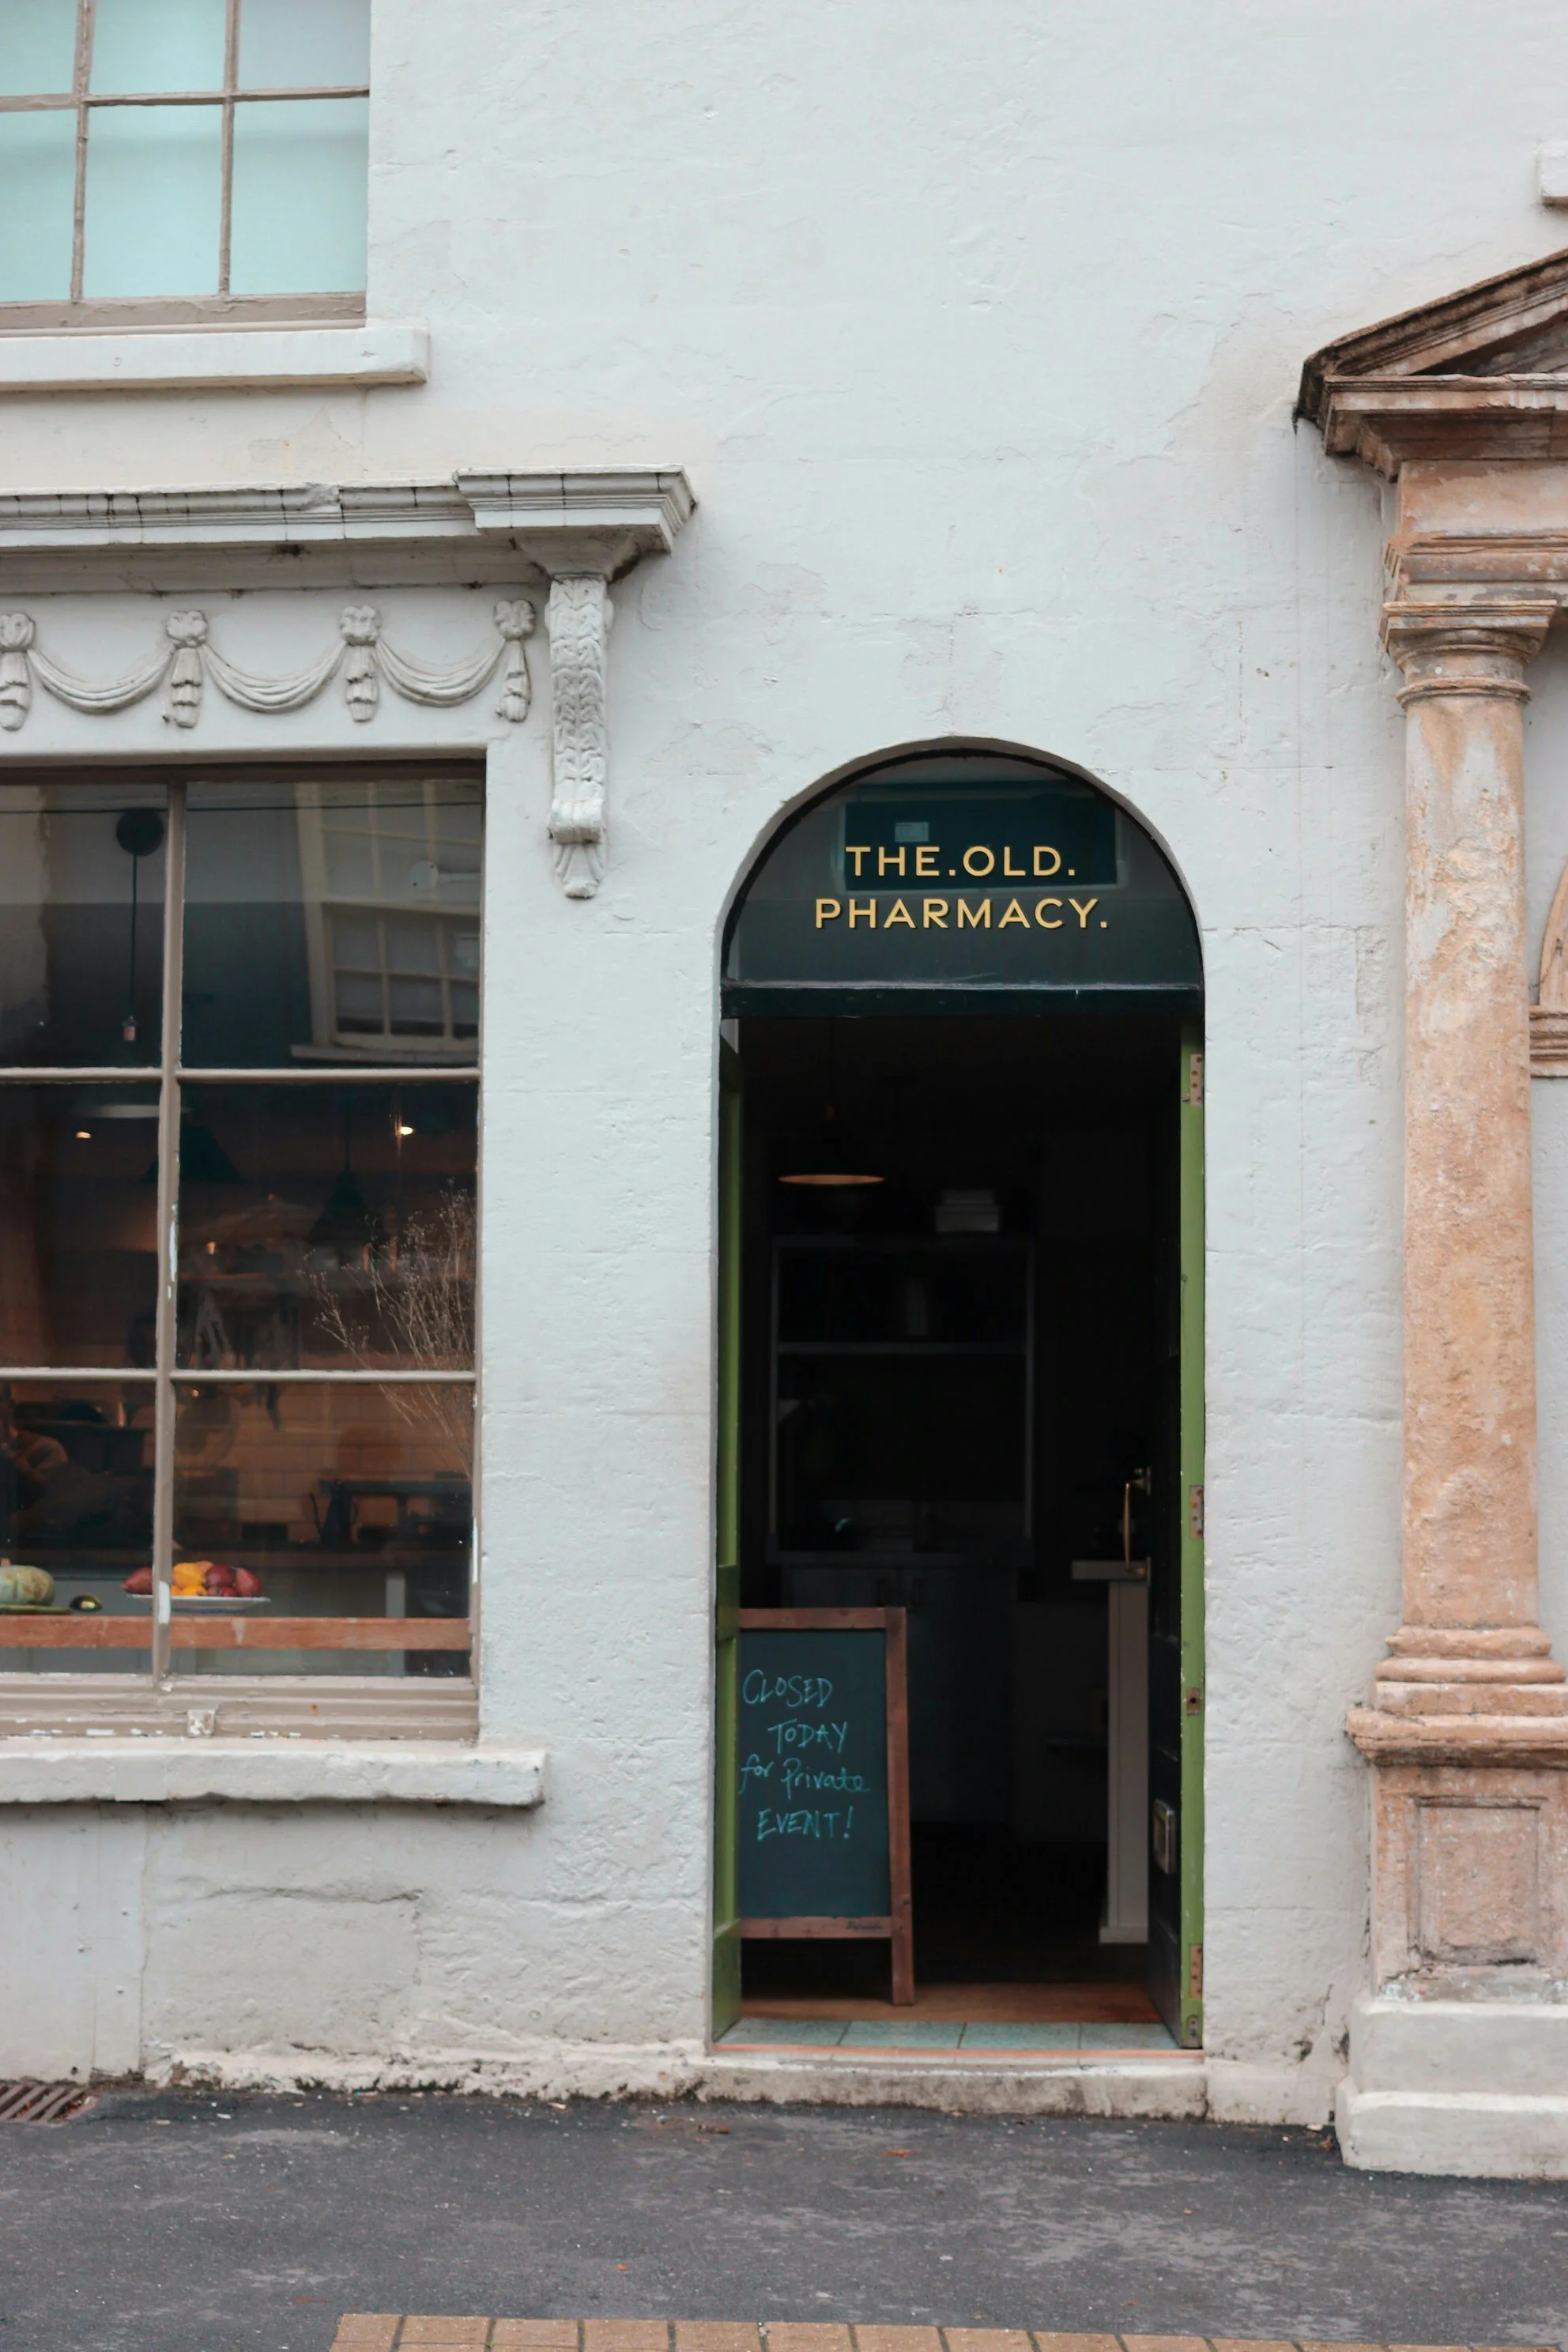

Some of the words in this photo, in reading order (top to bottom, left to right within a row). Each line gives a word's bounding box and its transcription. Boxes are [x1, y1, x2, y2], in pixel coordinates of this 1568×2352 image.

[815, 898, 1108, 929] PHARMACY.
[742, 1668, 833, 1708] CLOSED
[767, 1717, 848, 1754] TODAY
[738, 1753, 775, 1795] for
[781, 1757, 870, 1800] Private
[756, 1805, 854, 1841] EVENT!
